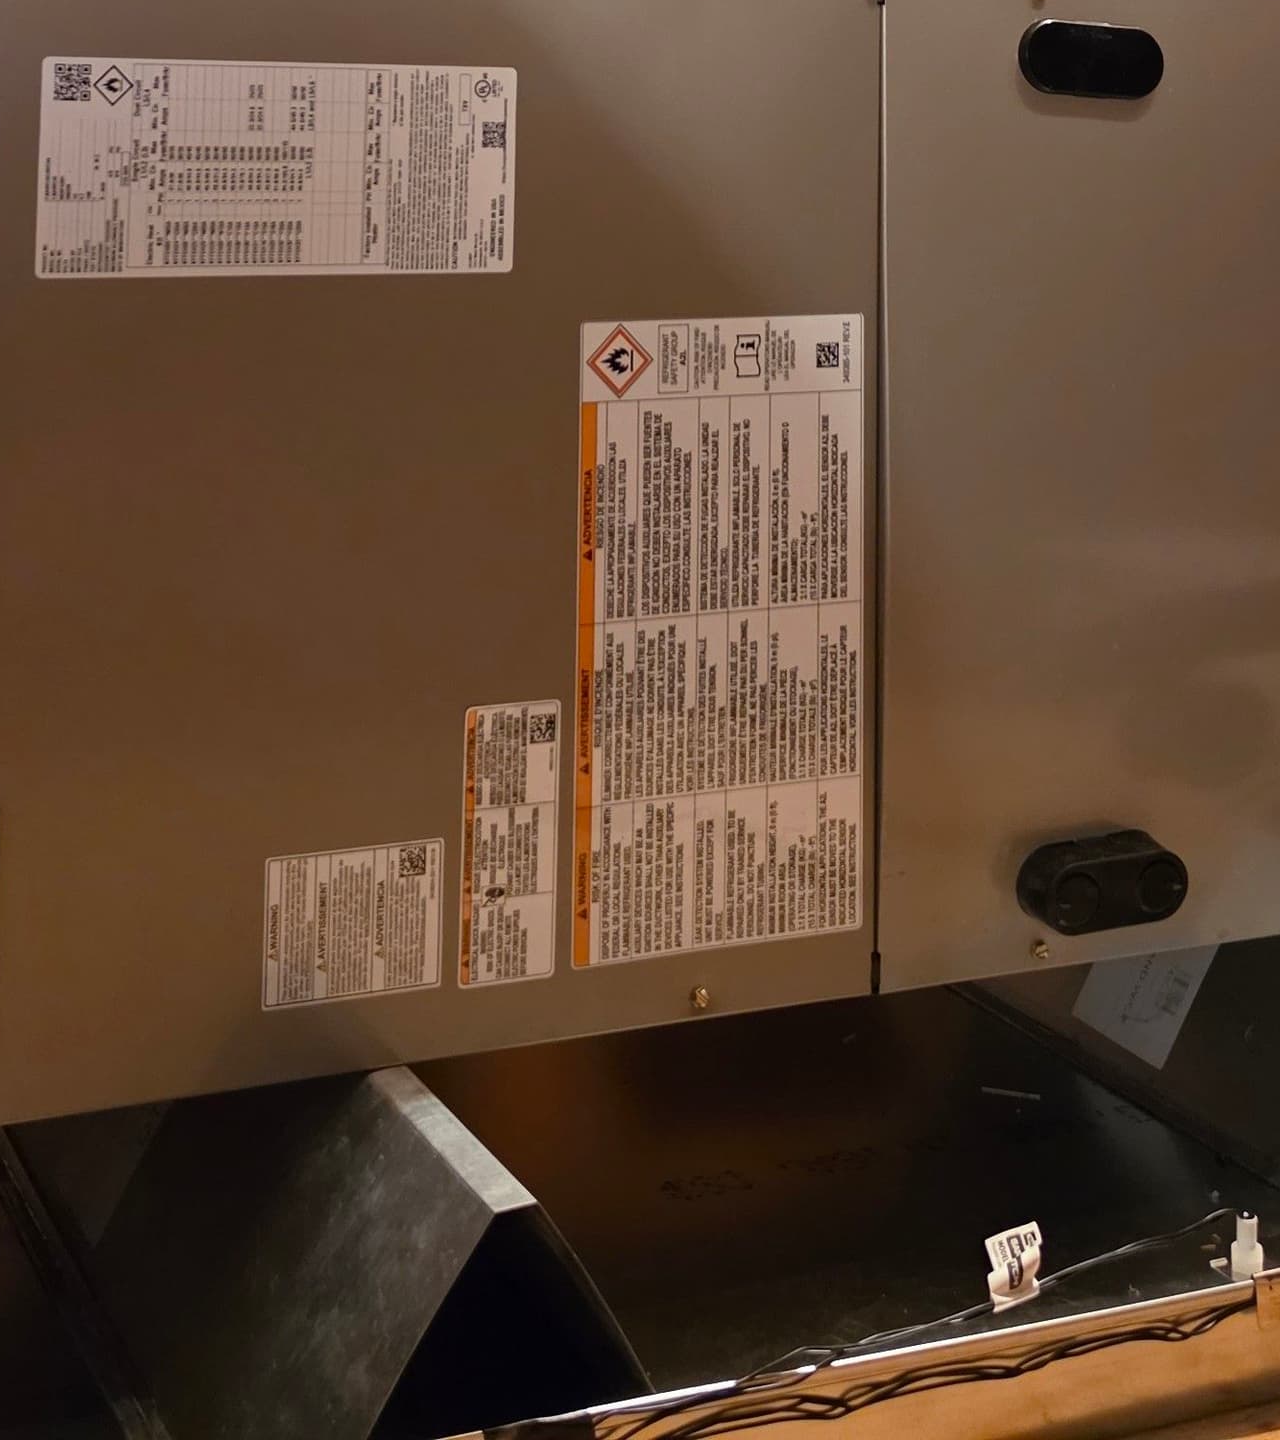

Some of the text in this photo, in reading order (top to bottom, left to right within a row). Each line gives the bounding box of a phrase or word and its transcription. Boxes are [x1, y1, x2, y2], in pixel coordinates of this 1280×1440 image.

[269, 904, 279, 950] WARNING
[318, 882, 327, 960] AVERTISSEMENT
[375, 880, 384, 946] ADVERTENCIA
